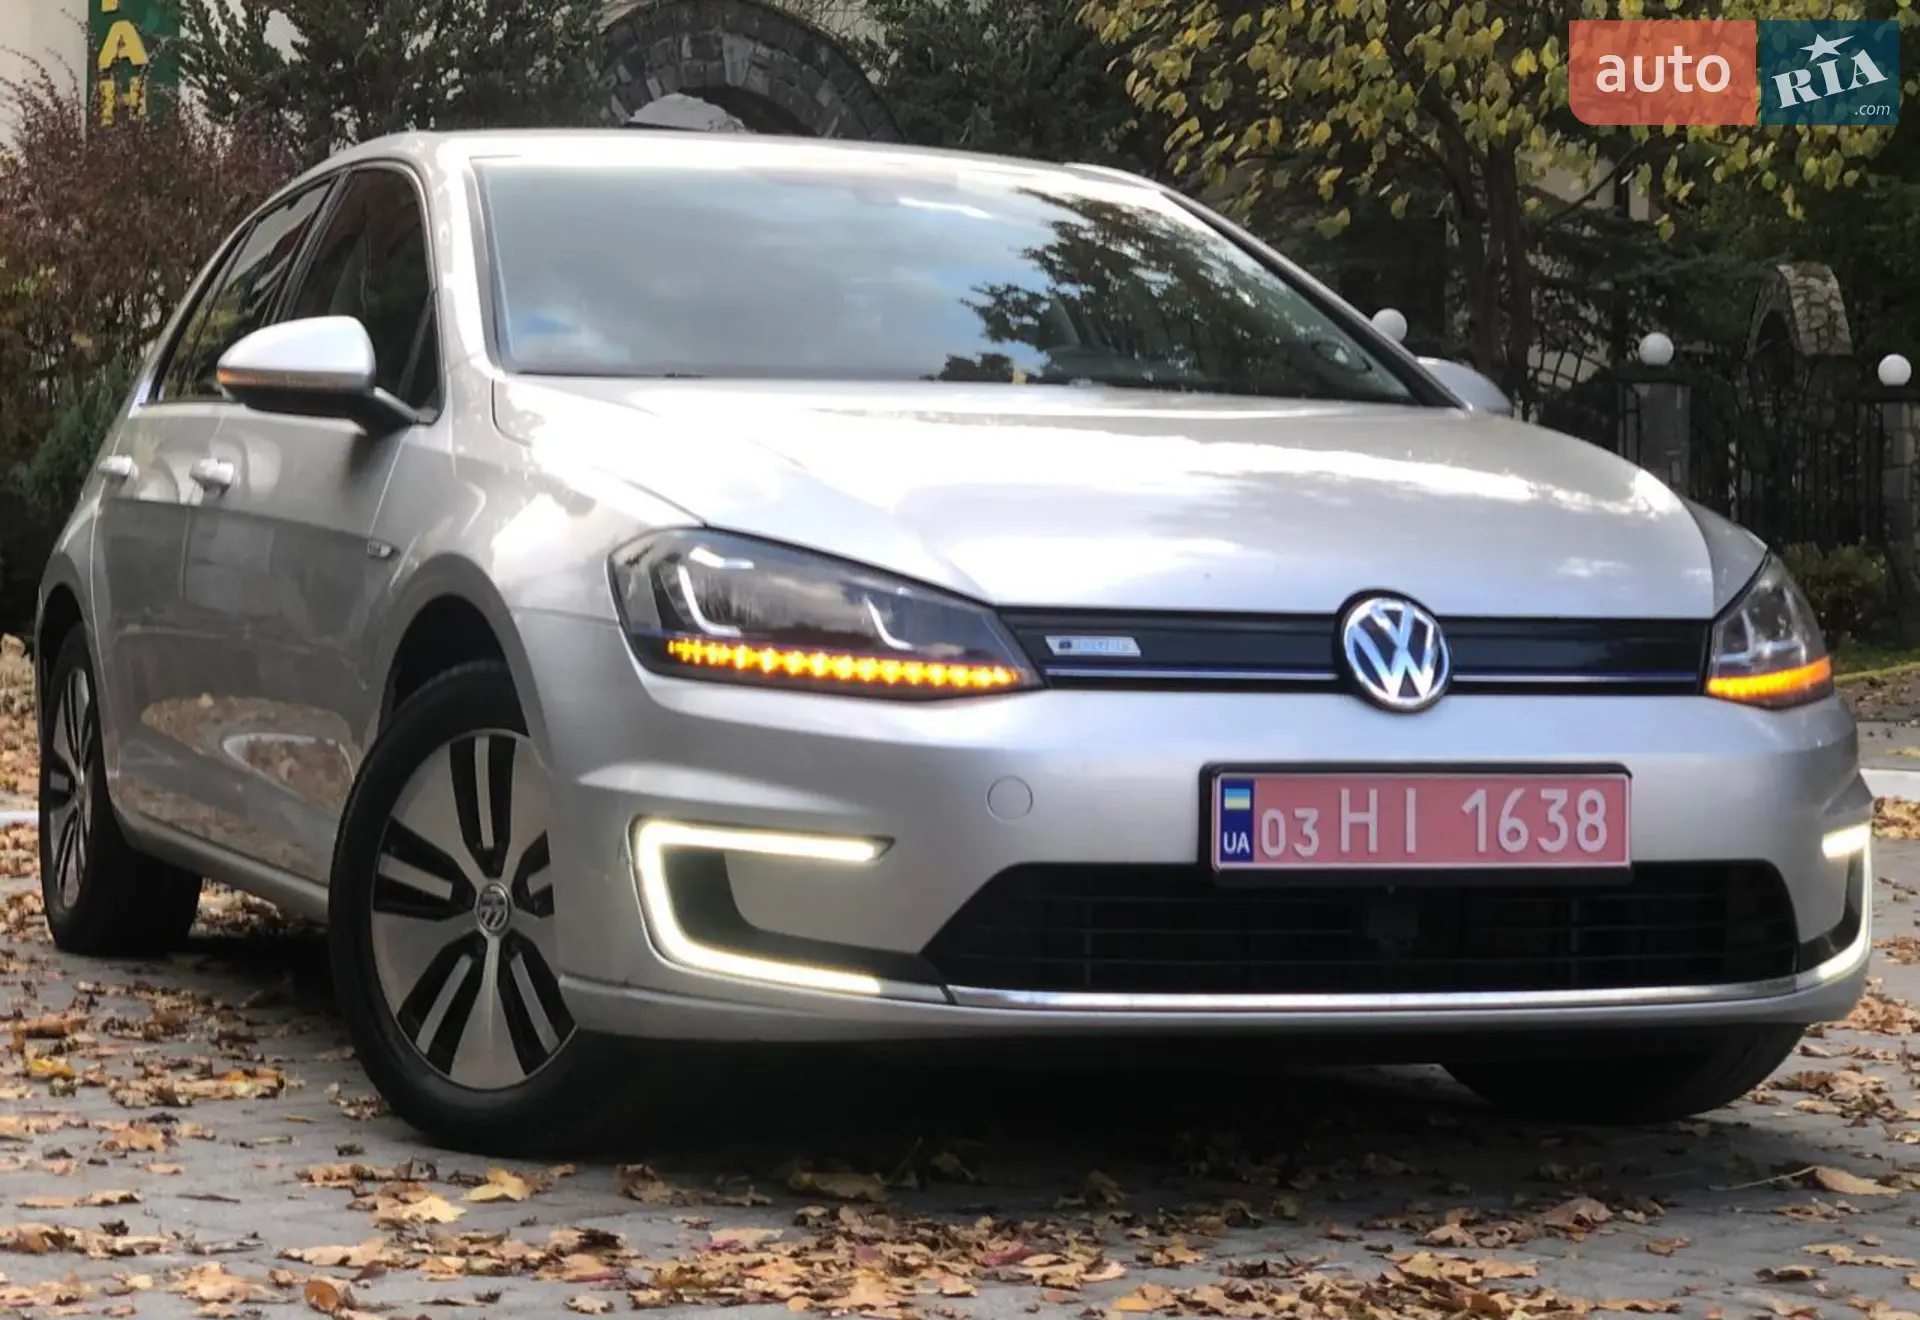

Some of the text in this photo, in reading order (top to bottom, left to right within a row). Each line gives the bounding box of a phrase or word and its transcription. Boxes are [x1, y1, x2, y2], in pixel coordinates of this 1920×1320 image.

[1223, 832, 1251, 854] UA
[1261, 788, 1608, 857] 03 HI 1638
